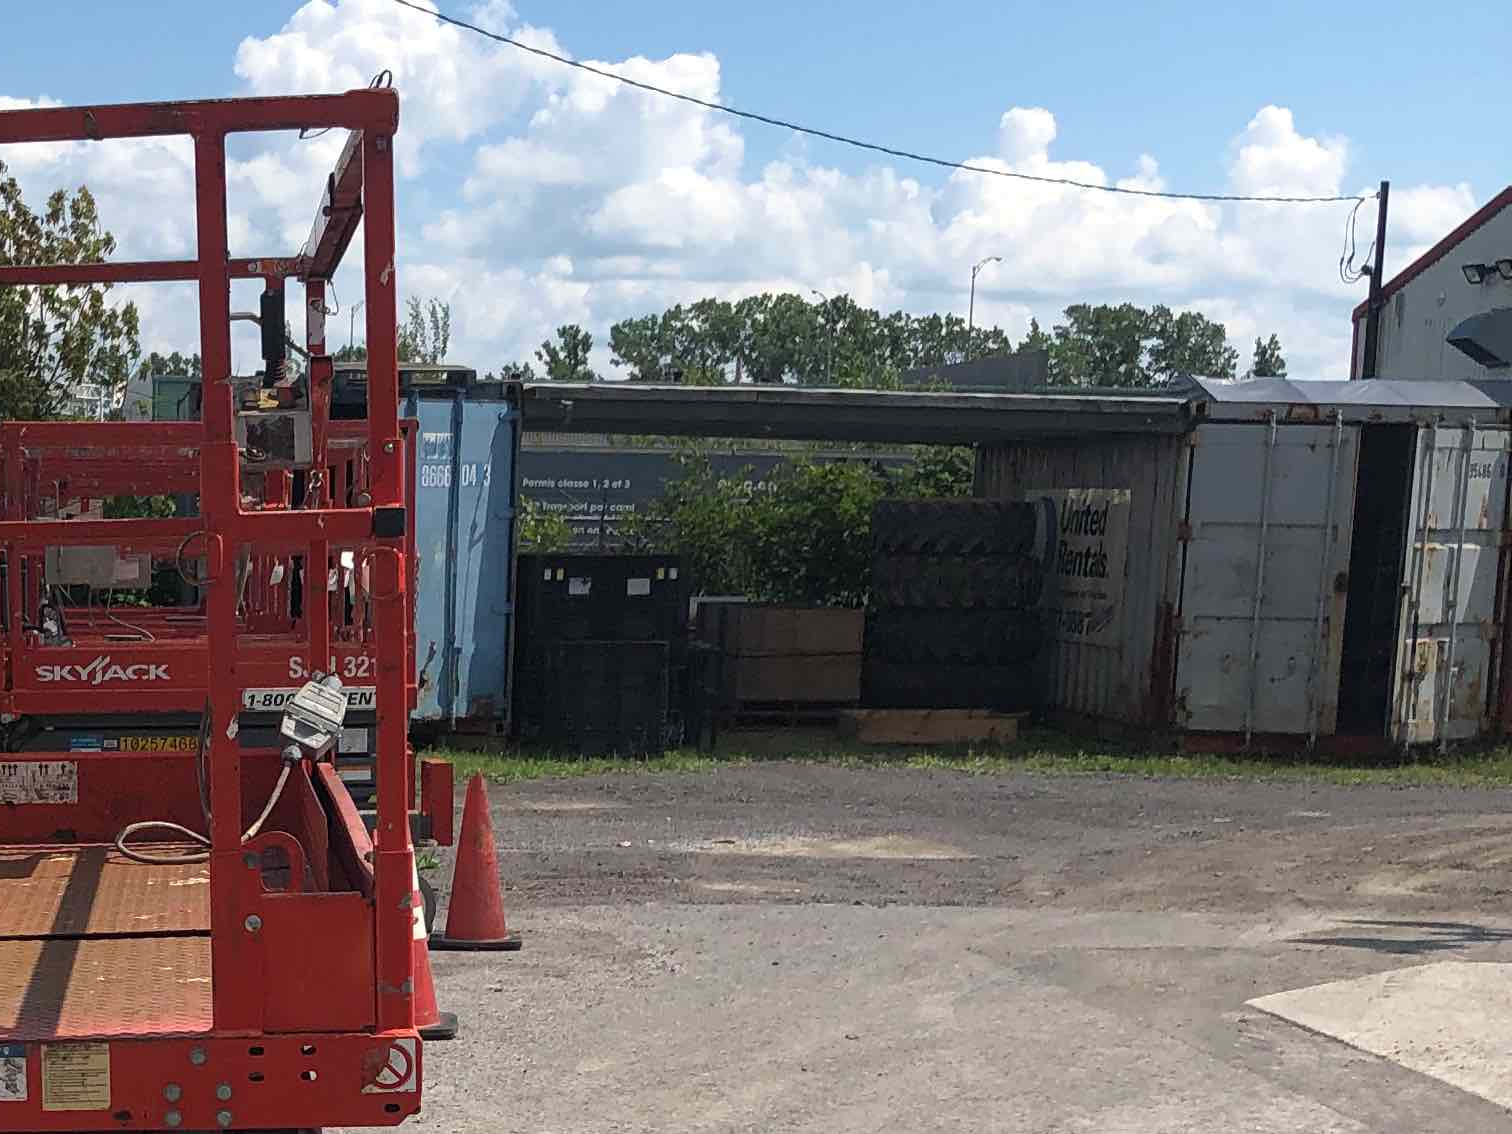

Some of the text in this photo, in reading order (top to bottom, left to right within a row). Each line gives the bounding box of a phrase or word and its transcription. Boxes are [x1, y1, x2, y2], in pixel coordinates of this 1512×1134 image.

[522, 477, 555, 489] Permis
[557, 477, 589, 489] classe
[602, 479, 610, 489] 2
[611, 479, 622, 489] et
[624, 479, 631, 489] 3
[1060, 499, 1110, 537] United
[35, 655, 171, 686] SKYJACK
